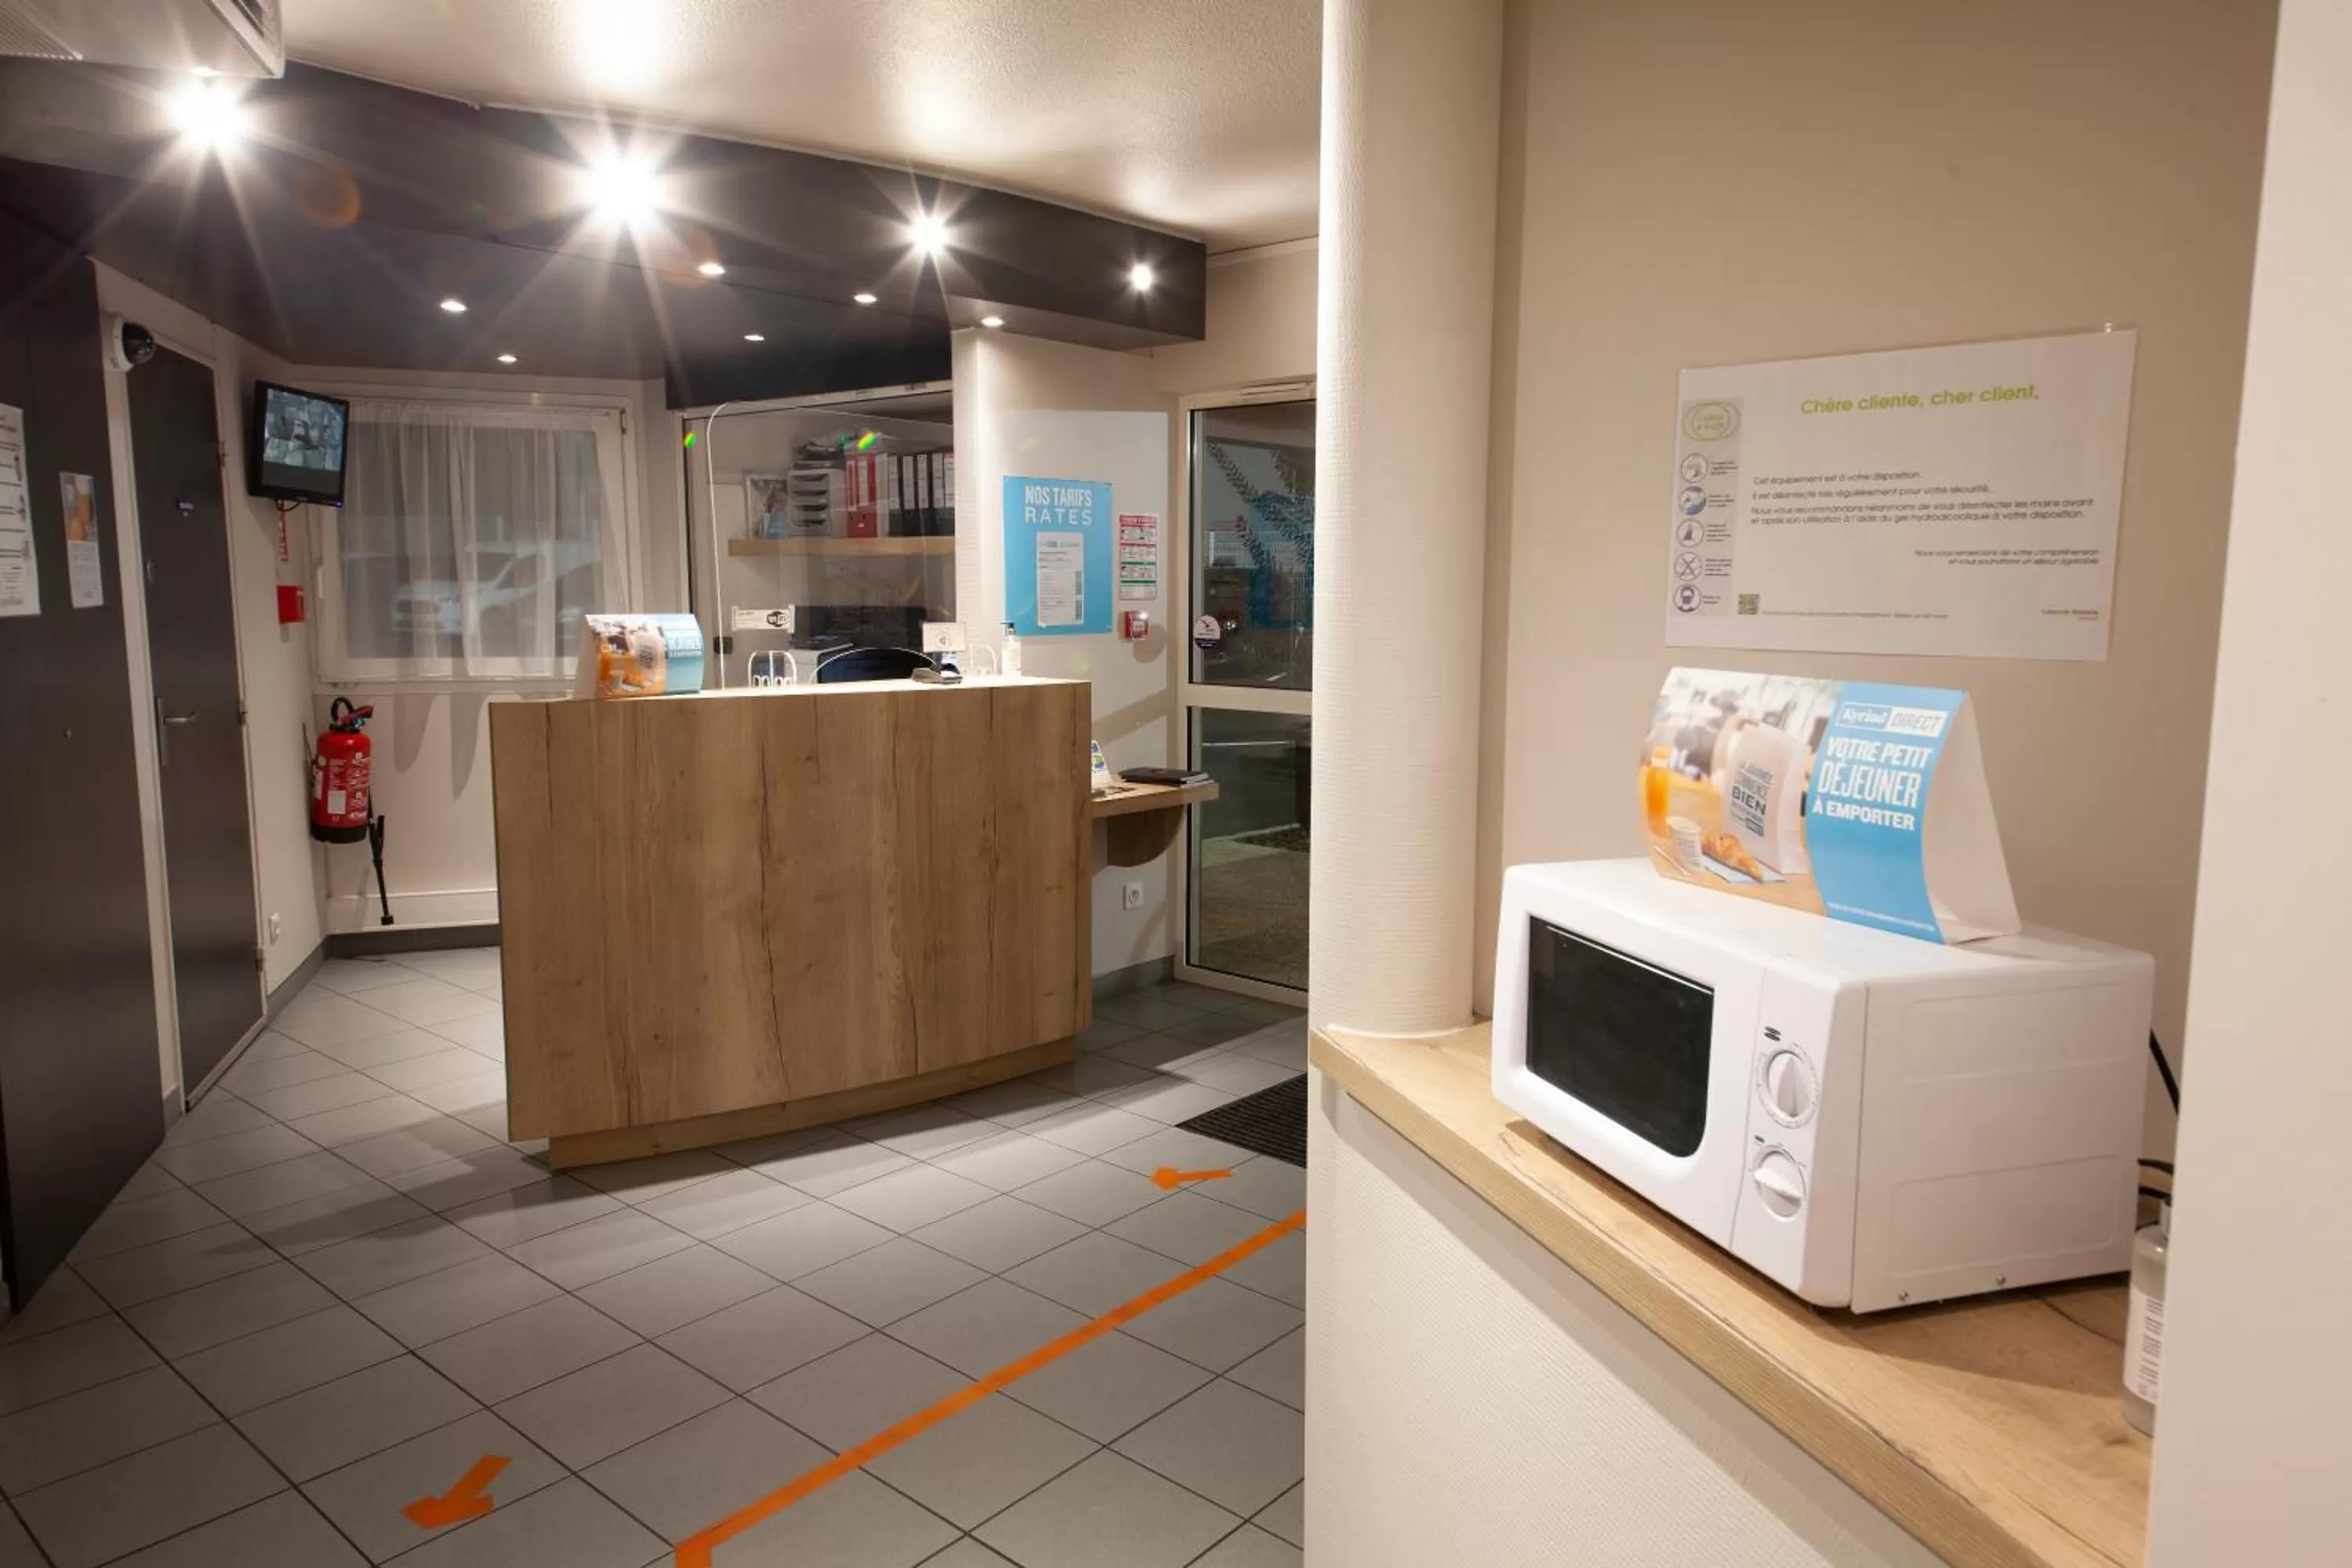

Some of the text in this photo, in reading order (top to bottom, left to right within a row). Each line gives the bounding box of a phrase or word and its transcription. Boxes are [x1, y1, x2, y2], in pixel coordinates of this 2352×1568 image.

[1800, 397, 1853, 414] Chère
[1857, 392, 1924, 412] cliente,
[1930, 390, 1974, 406] cher
[1025, 485, 1092, 508] NOS TARIFS
[1025, 506, 1092, 526] RATES
[1827, 736, 1933, 769] VOTRE PETIT
[1731, 785, 1767, 816] BIEN
[1813, 795, 1916, 832] À EMPORTER
